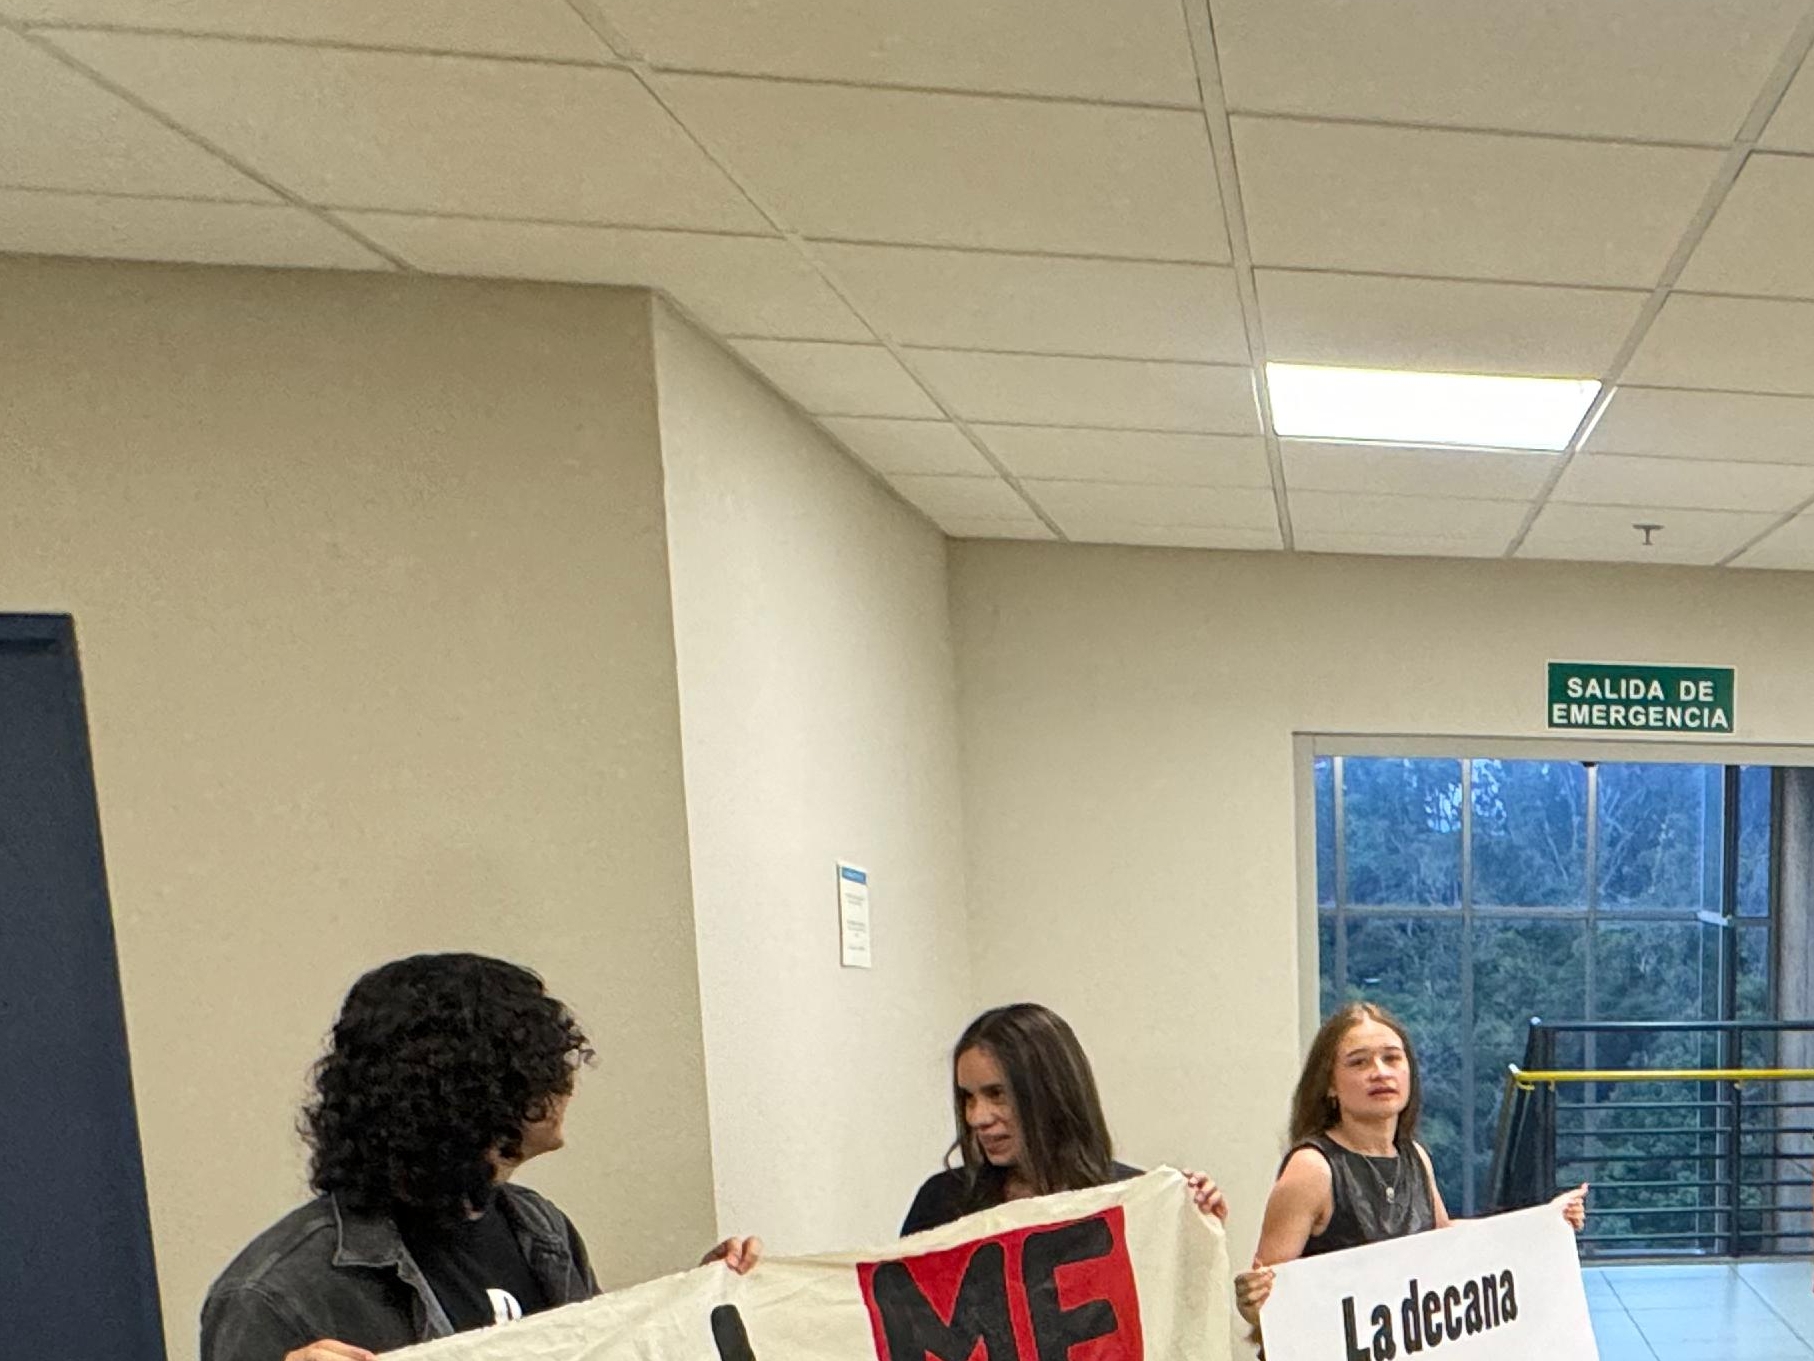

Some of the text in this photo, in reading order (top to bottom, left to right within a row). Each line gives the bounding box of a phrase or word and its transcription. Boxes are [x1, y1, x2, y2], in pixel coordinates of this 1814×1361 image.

[1566, 677, 1714, 702] SALIDA DE
[1552, 703, 1730, 729] EMERGENCIA
[1401, 1268, 1519, 1355] decana
